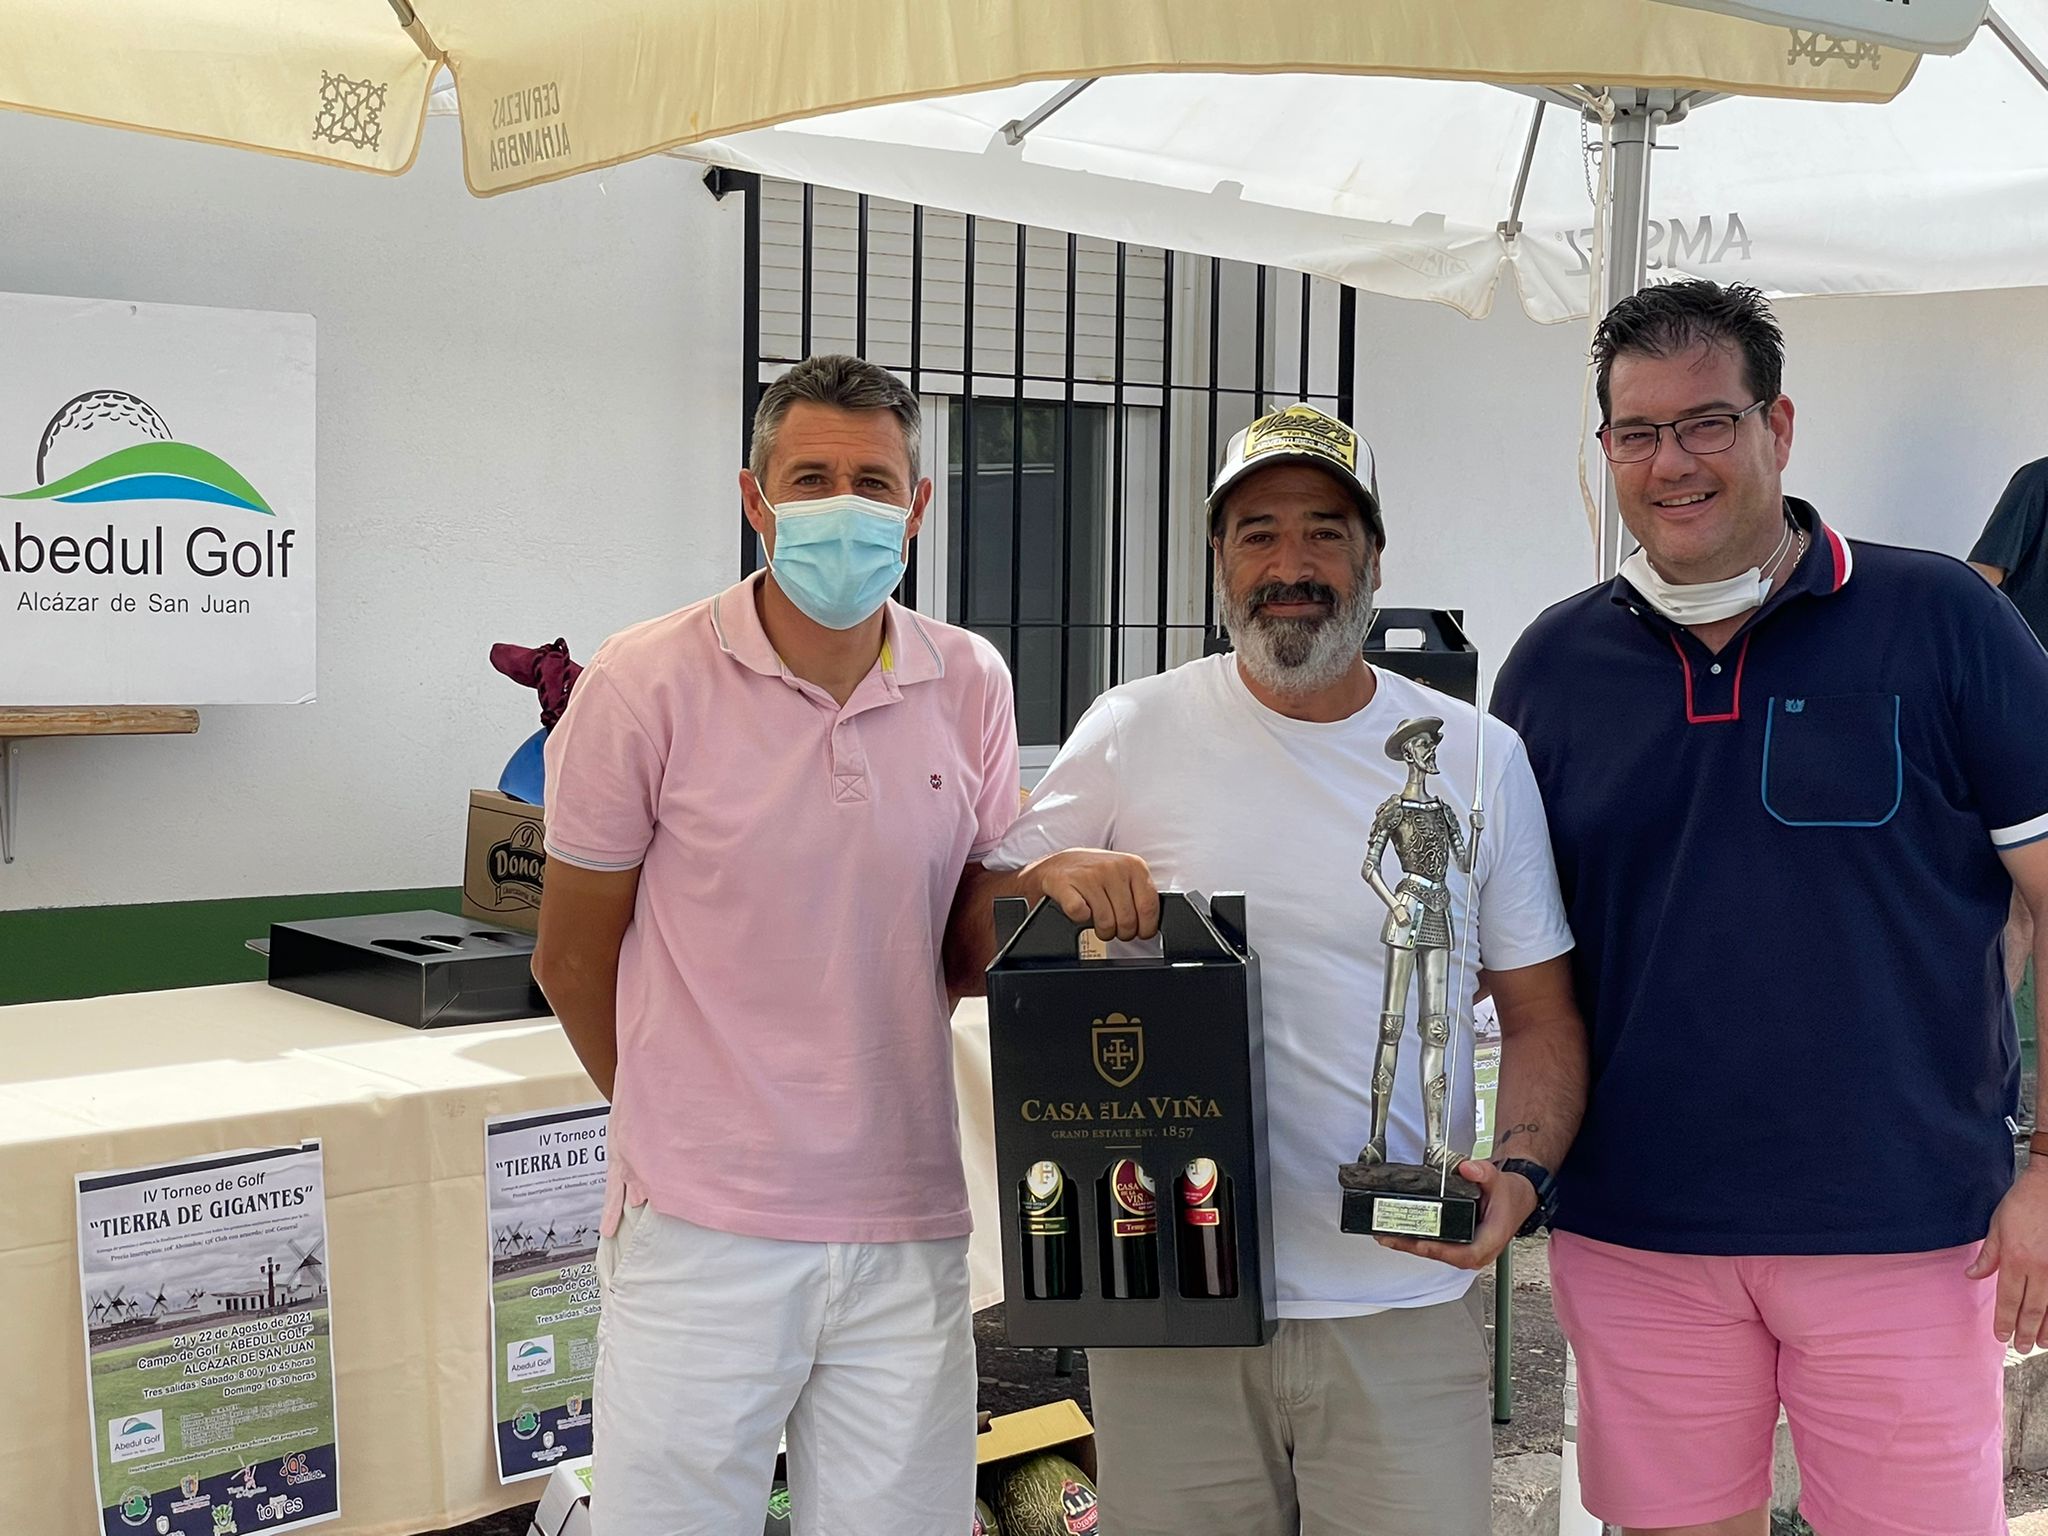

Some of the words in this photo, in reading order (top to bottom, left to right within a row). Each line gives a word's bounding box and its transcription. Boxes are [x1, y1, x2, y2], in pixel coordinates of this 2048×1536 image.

[186, 526, 296, 578] Golf
[16, 591, 98, 611] Alcázar
[110, 593, 136, 612] de
[149, 593, 189, 613] San
[201, 594, 250, 614] Juan
[1111, 1101, 1146, 1120] LA
[1148, 1095, 1223, 1119] VIÑA
[540, 1134, 551, 1146] IV
[554, 1129, 596, 1144] Torneo
[599, 1125, 607, 1137] d
[1052, 1129, 1089, 1139] GRAND
[1092, 1128, 1132, 1138] ESTATE
[1135, 1128, 1157, 1138] EST.
[1162, 1125, 1194, 1139] 1857
[567, 1148, 589, 1167] DE
[144, 1189, 158, 1204] IV
[162, 1184, 211, 1201] Torneo
[216, 1179, 233, 1192] de
[237, 1172, 266, 1188] Golf
[1117, 1183, 1139, 1191] CASA
[177, 1204, 203, 1225] DE
[560, 1268, 571, 1279] 21
[573, 1269, 579, 1278] y
[581, 1263, 592, 1274] 22
[531, 1285, 563, 1298] Campo
[566, 1280, 577, 1290] de
[579, 1276, 598, 1288] Golf
[569, 1289, 600, 1303] ALCAZ
[174, 1334, 186, 1347] 21
[190, 1336, 197, 1346] y
[199, 1330, 212, 1343] 22
[215, 1328, 228, 1339] de
[231, 1321, 268, 1339] Agosto
[271, 1316, 284, 1328] de
[287, 1312, 312, 1325] 2021
[537, 1316, 553, 1325] Tres
[138, 1355, 177, 1369] Campo
[180, 1351, 193, 1362] de
[197, 1344, 220, 1358] Golf
[241, 1353, 256, 1364] DE
[258, 1348, 282, 1360] SAN
[285, 1341, 315, 1355] JUAN
[511, 1361, 536, 1372] Abedul
[537, 1358, 552, 1366] Golf
[144, 1388, 163, 1399] Tres
[238, 1368, 258, 1380] 8:00
[259, 1368, 265, 1377] y
[267, 1361, 290, 1374] 10:45
[291, 1358, 315, 1370] horas
[267, 1376, 290, 1388] 10:30
[292, 1372, 316, 1384] horas
[114, 1438, 142, 1451] Abedul
[144, 1434, 161, 1445] Golf
